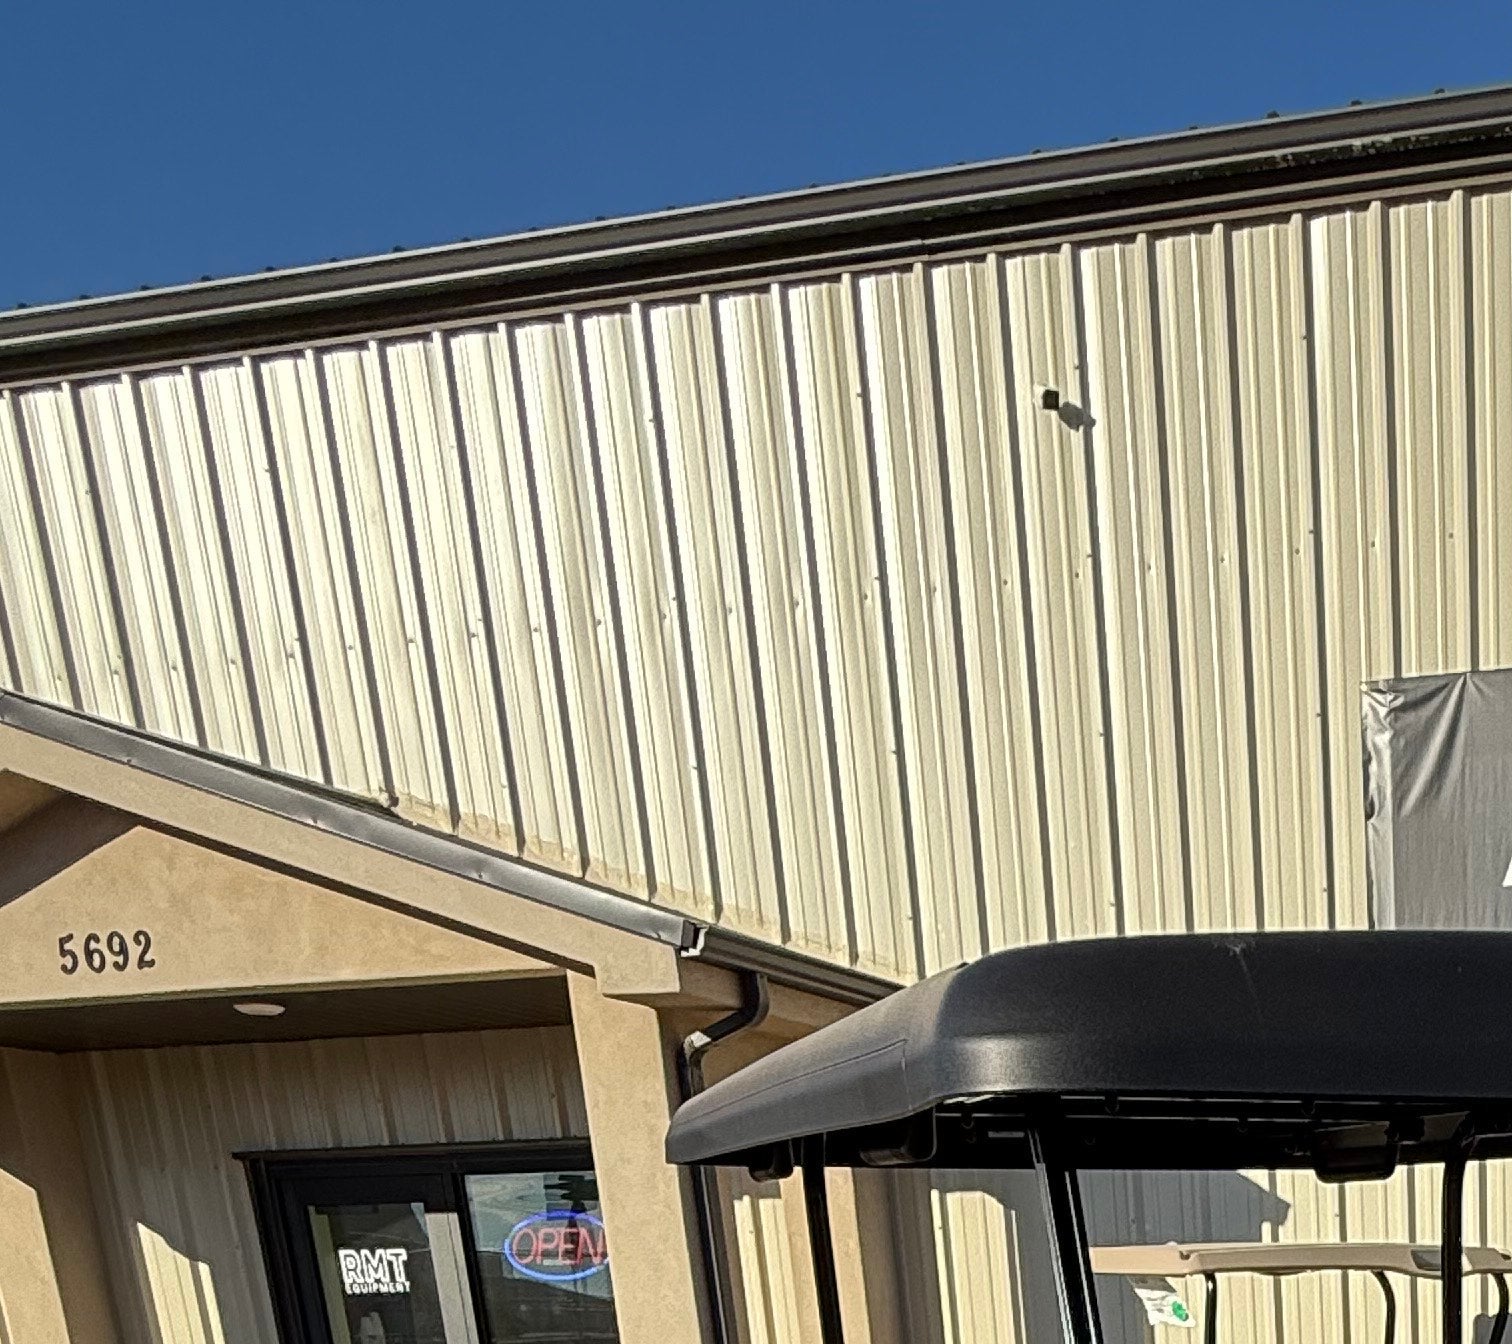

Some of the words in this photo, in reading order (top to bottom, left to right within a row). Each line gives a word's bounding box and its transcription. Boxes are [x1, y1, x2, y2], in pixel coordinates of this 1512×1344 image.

[58, 930, 156, 975] 5692
[511, 1226, 608, 1266] OPEN
[338, 1248, 408, 1284] RMT
[345, 1281, 411, 1295] EQUIPMENT
